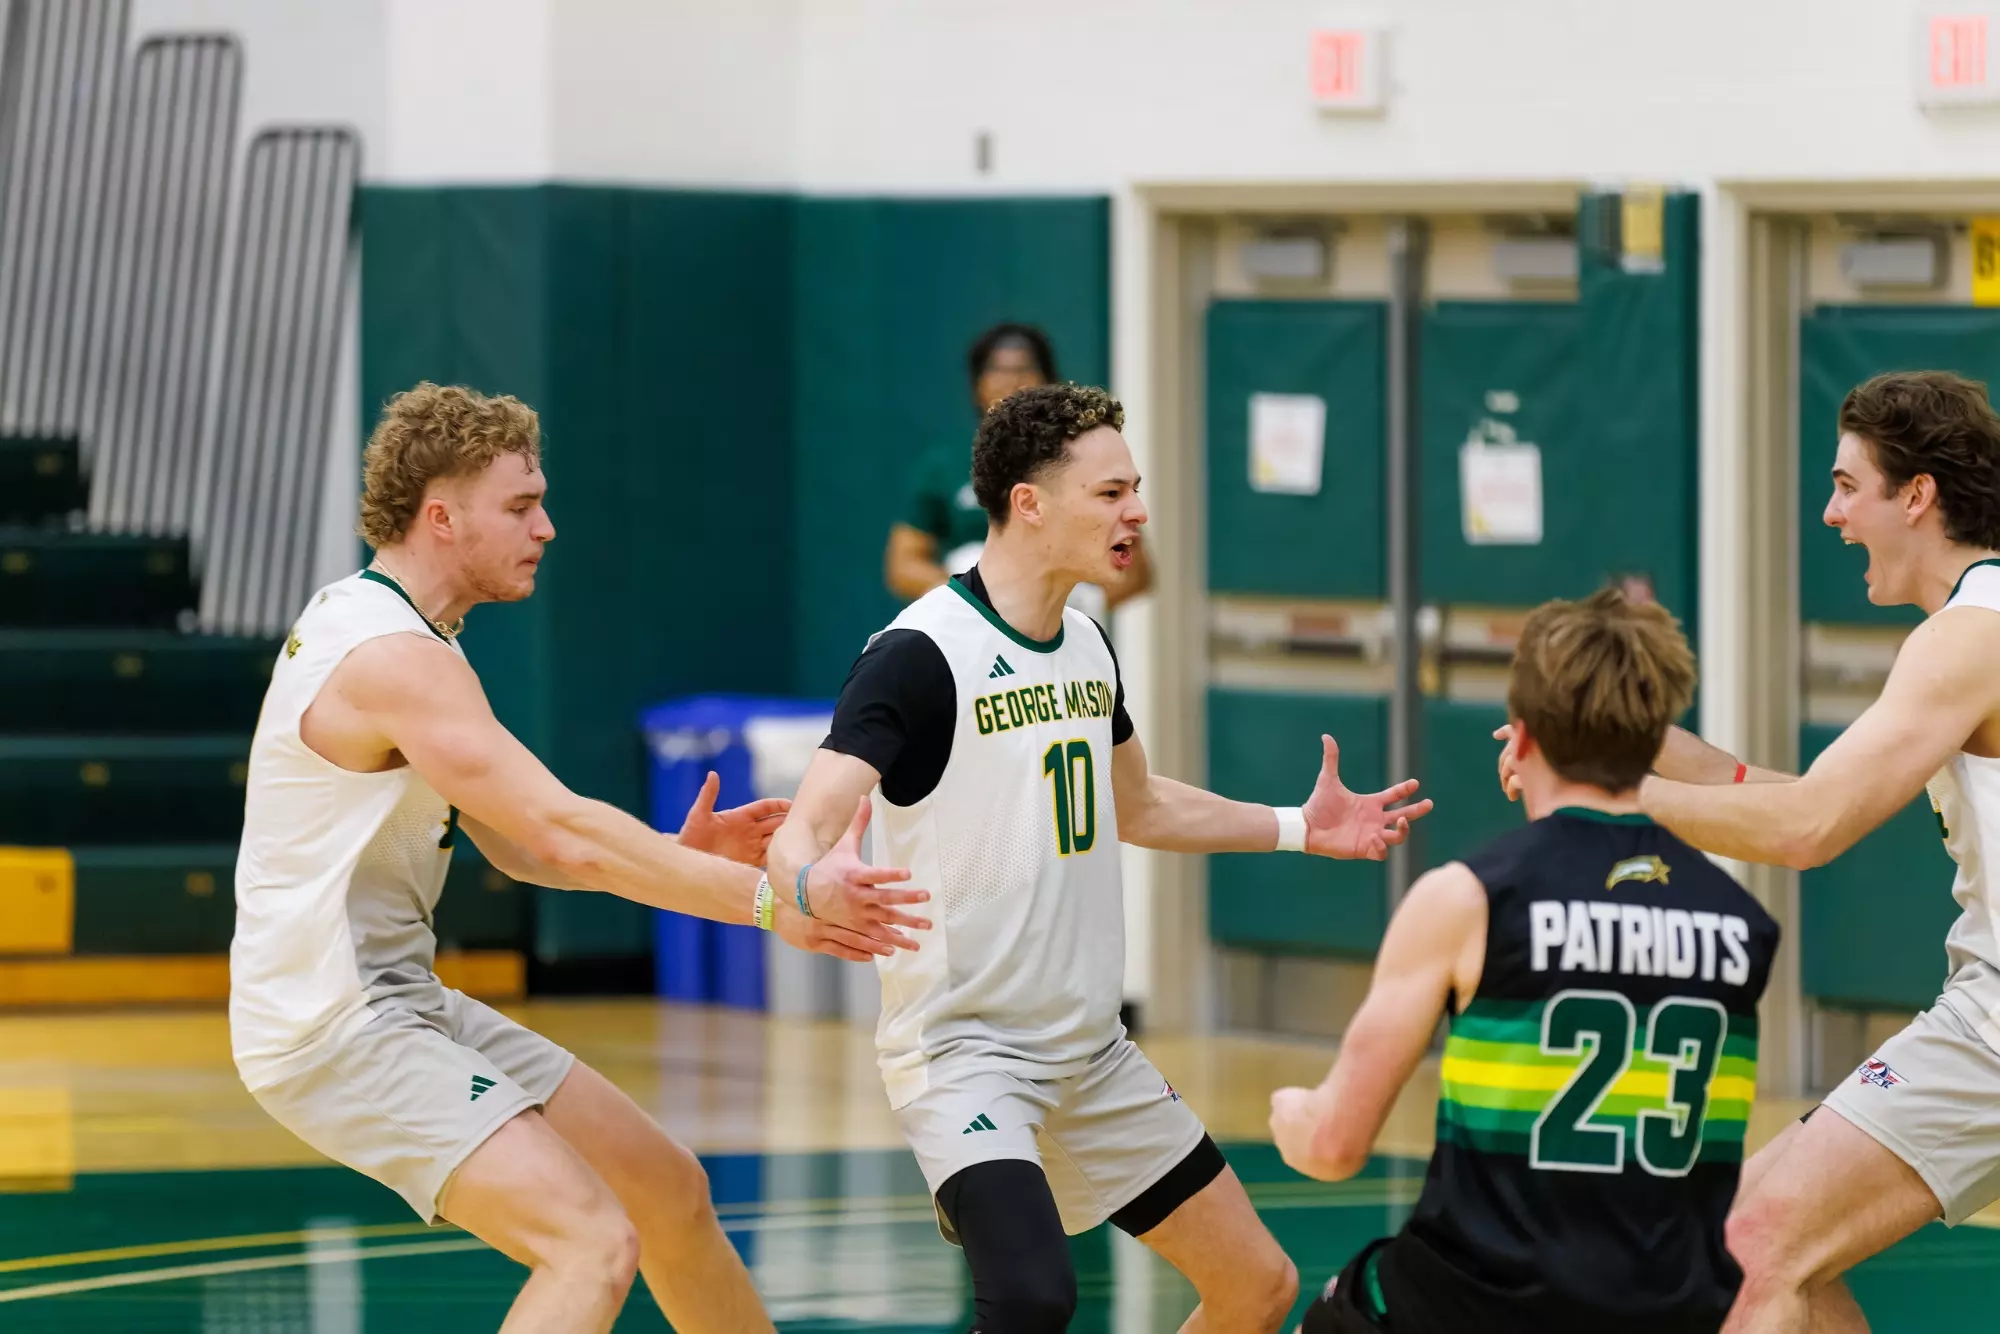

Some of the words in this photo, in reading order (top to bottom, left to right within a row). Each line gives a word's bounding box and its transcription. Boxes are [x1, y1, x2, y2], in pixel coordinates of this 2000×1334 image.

[974, 682, 1063, 736] GEORGE
[1063, 680, 1113, 719] MASON
[1042, 737, 1096, 858] 10
[1528, 900, 1751, 987] PATRIOTS
[1528, 988, 1729, 1178] 23
